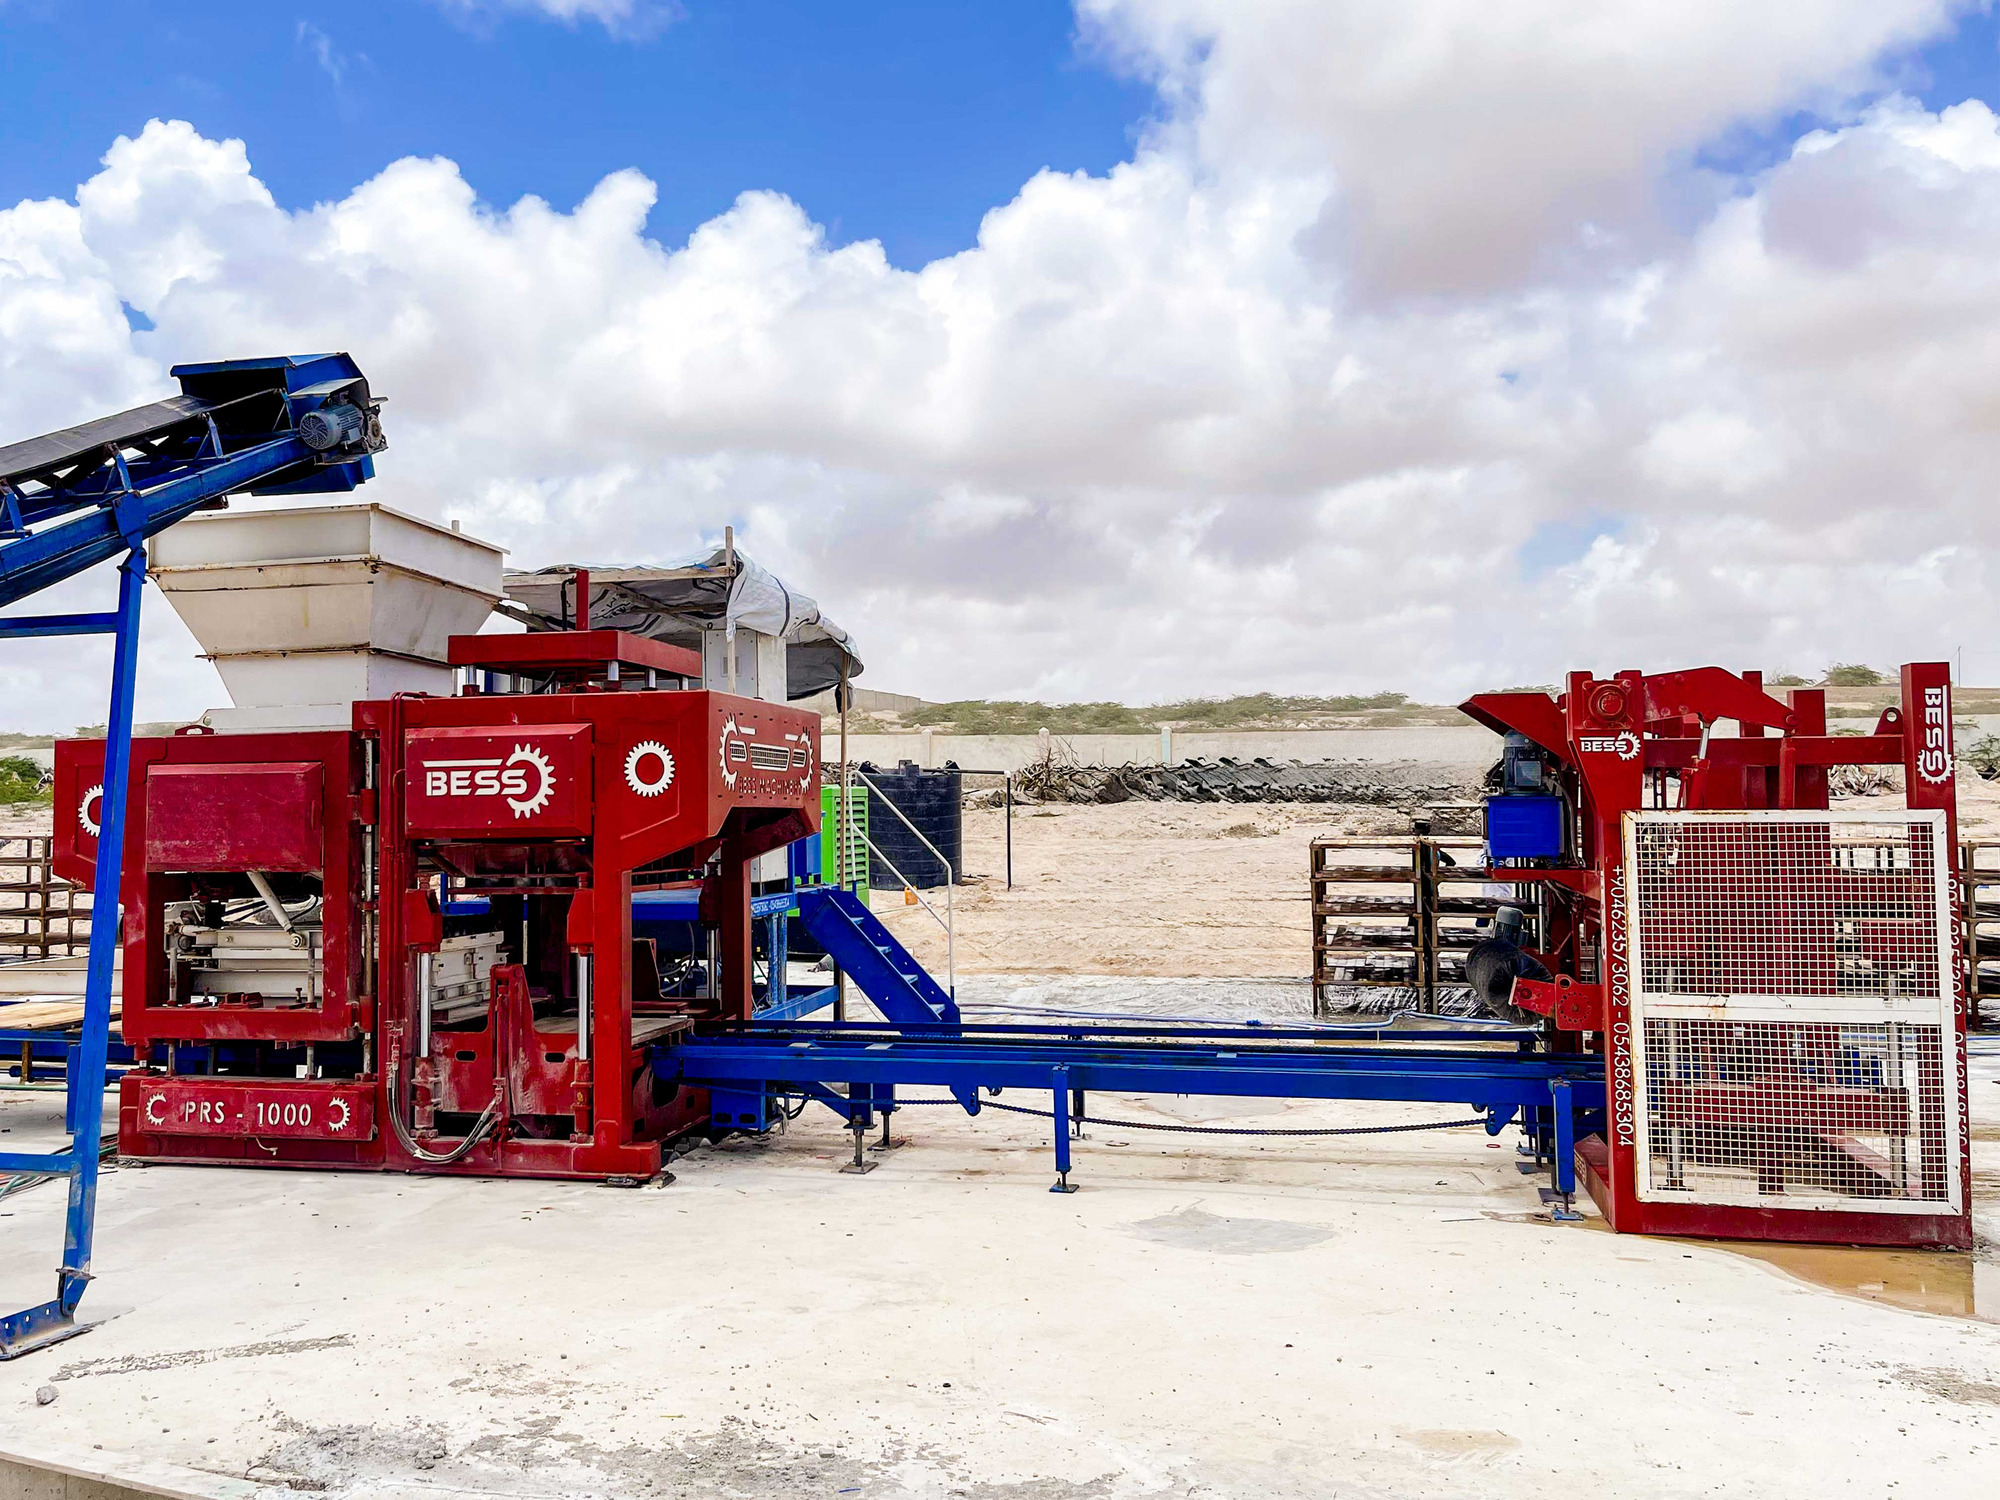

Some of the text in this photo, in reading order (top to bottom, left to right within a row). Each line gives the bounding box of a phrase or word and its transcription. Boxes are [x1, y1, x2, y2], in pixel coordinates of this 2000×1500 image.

[1925, 688, 1943, 771] BESS
[1581, 740, 1628, 752] BESS
[426, 768, 528, 796] BESS
[1613, 1022, 1635, 1147] 05438685304
[185, 1101, 225, 1124] PRS
[256, 1102, 312, 1126] 1000
